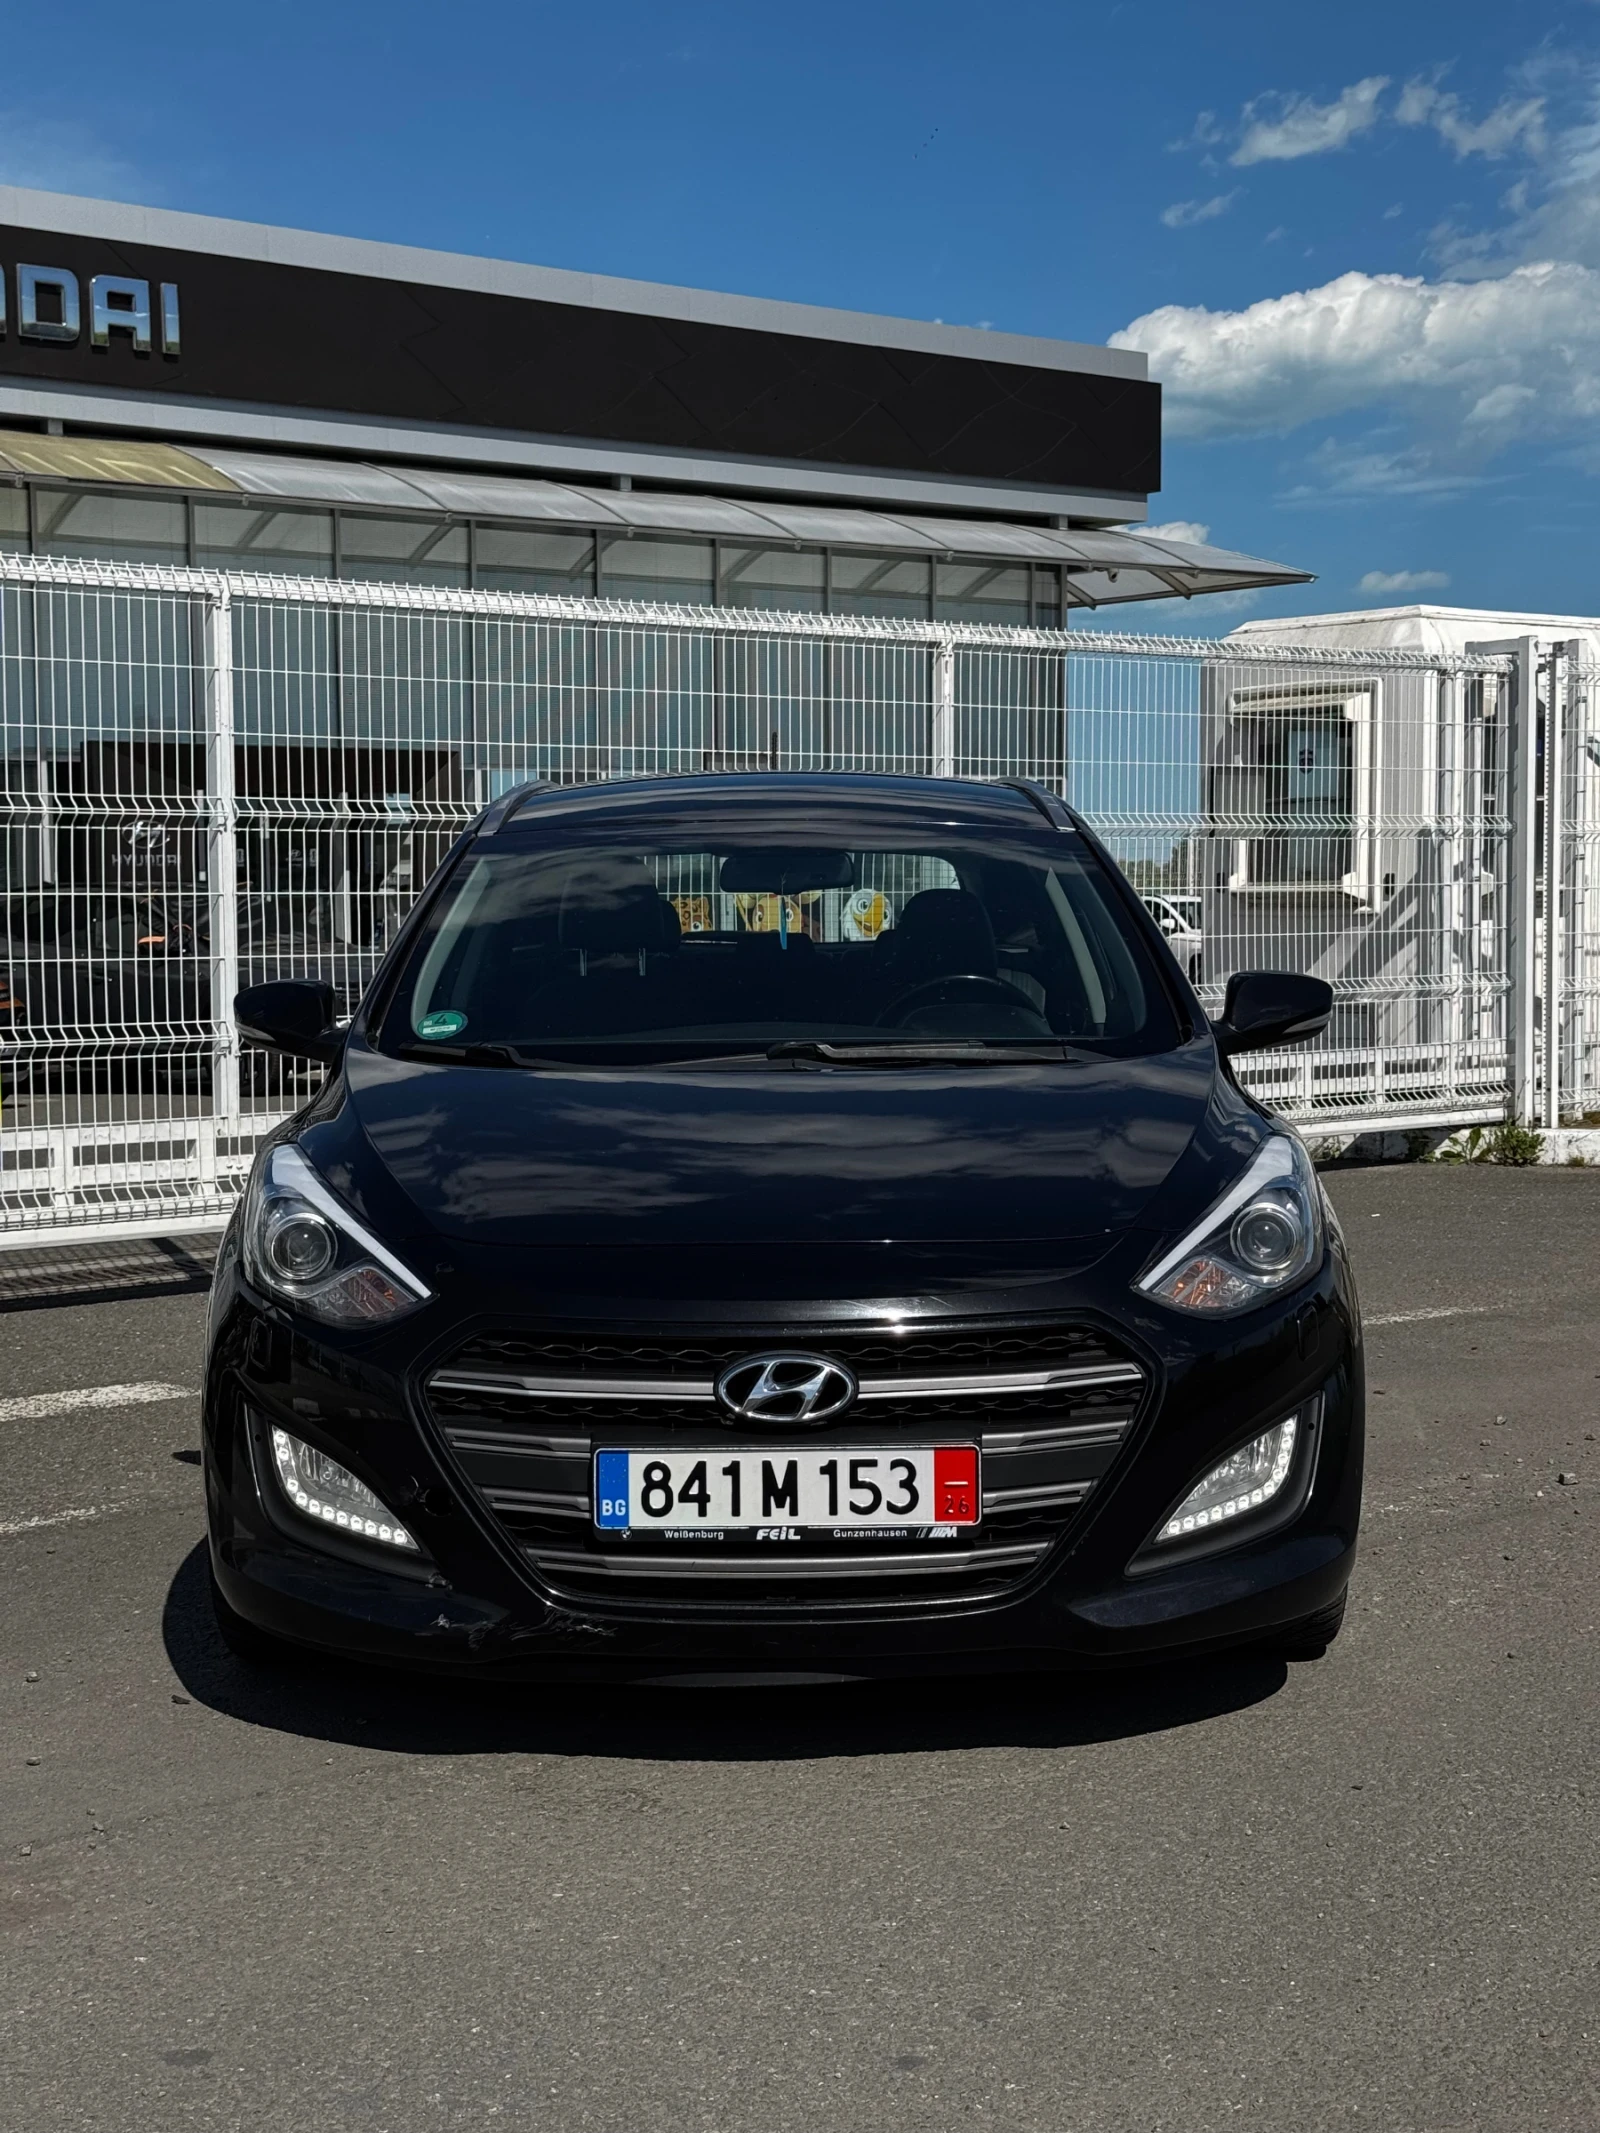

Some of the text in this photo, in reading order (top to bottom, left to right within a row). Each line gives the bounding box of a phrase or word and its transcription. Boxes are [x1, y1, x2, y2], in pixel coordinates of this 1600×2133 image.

[0, 263, 181, 355] DAI
[434, 1013, 448, 1025] 4
[601, 1498, 627, 1517] BG
[640, 1459, 742, 1518] 841
[761, 1459, 799, 1517] M
[819, 1458, 920, 1517] 153
[664, 1529, 725, 1541] Weißenburg
[833, 1528, 908, 1539] Gunzenhausen
